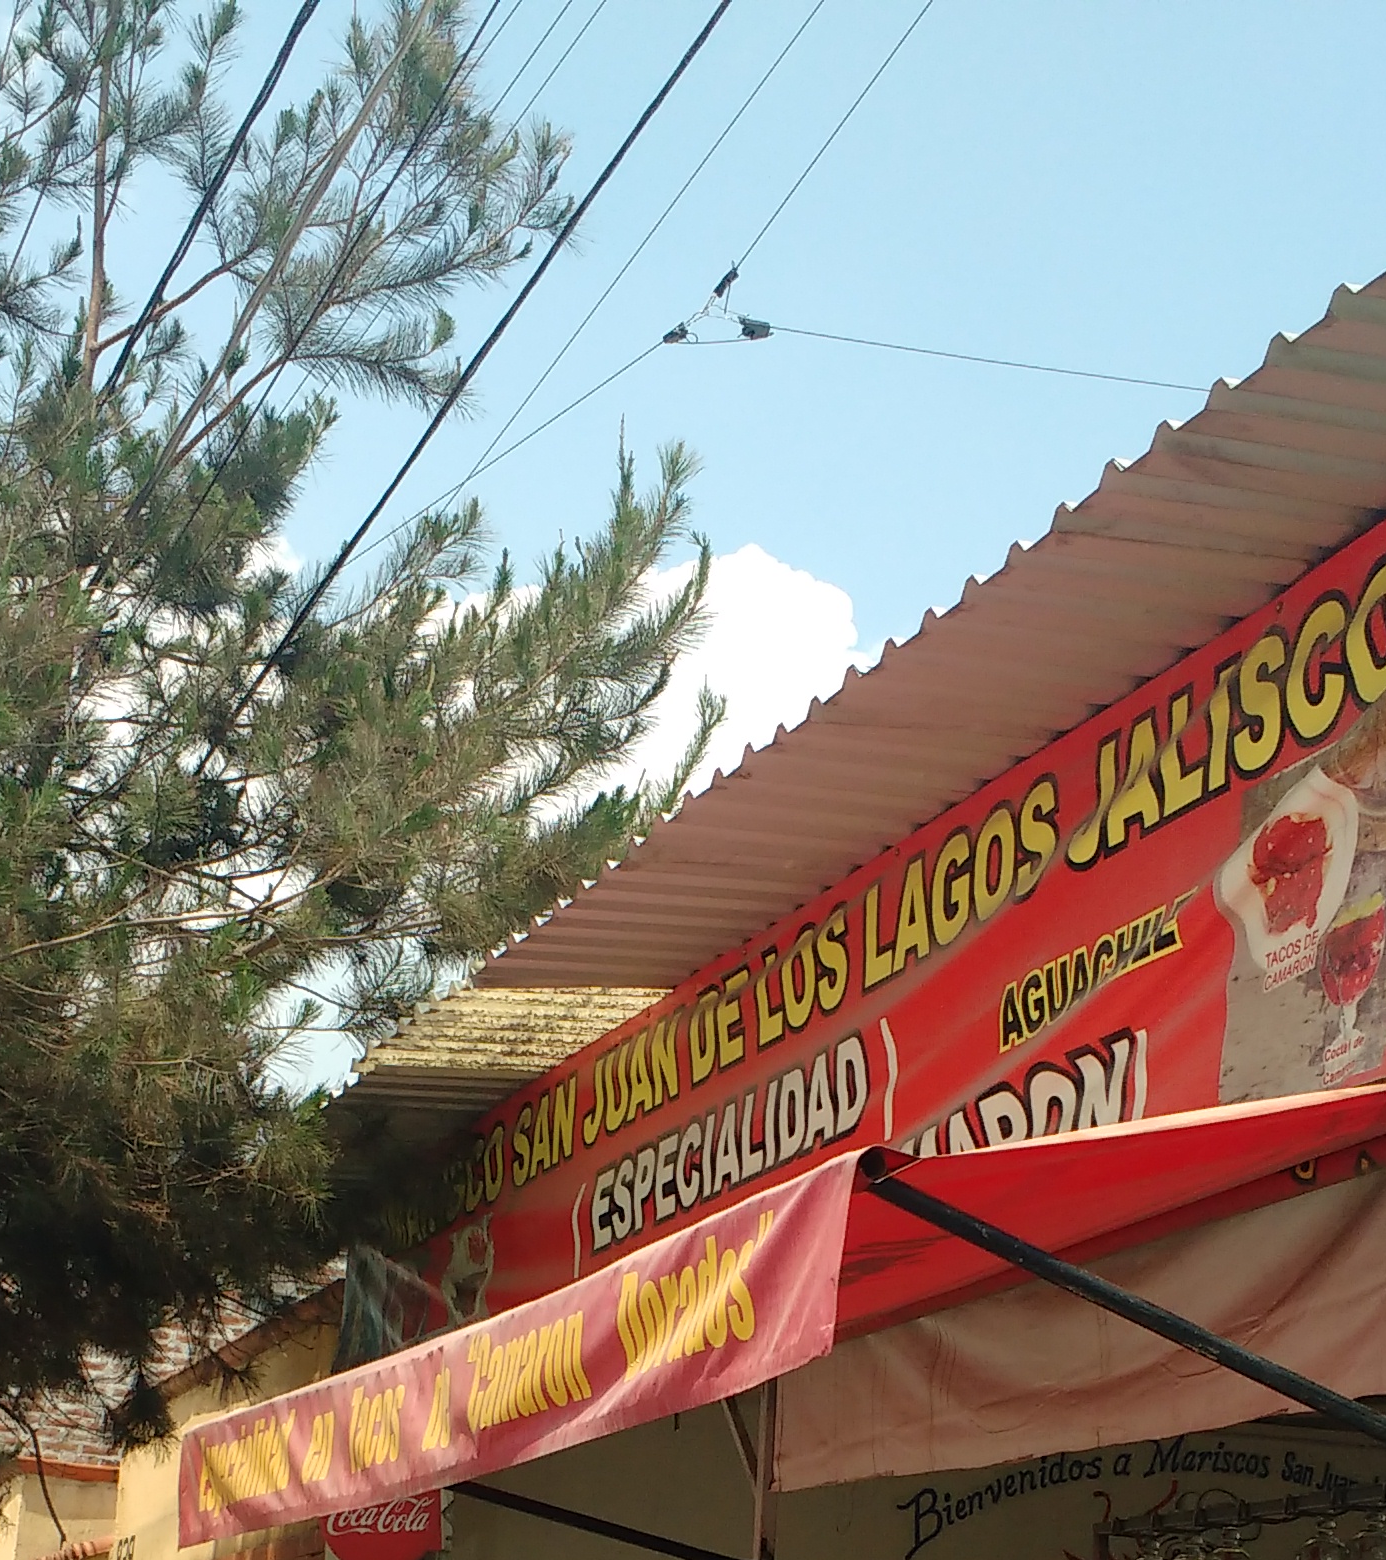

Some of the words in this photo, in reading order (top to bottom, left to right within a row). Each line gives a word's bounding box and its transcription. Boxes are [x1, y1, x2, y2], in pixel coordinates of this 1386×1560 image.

[1264, 954, 1315, 991] CAMARON
[1265, 938, 1302, 968] TACOS
[1303, 930, 1319, 951] DE
[511, 1072, 578, 1188] SAN
[582, 1014, 680, 1147] JUAN
[690, 968, 748, 1086] DE
[755, 899, 851, 1051] LOS
[861, 774, 1061, 998] LAGOS
[302, 1411, 335, 1484] en
[350, 1384, 405, 1473] Tacos
[1112, 1456, 1131, 1477] a
[1144, 1436, 1270, 1478] Mariscos
[1282, 1450, 1314, 1486] San
